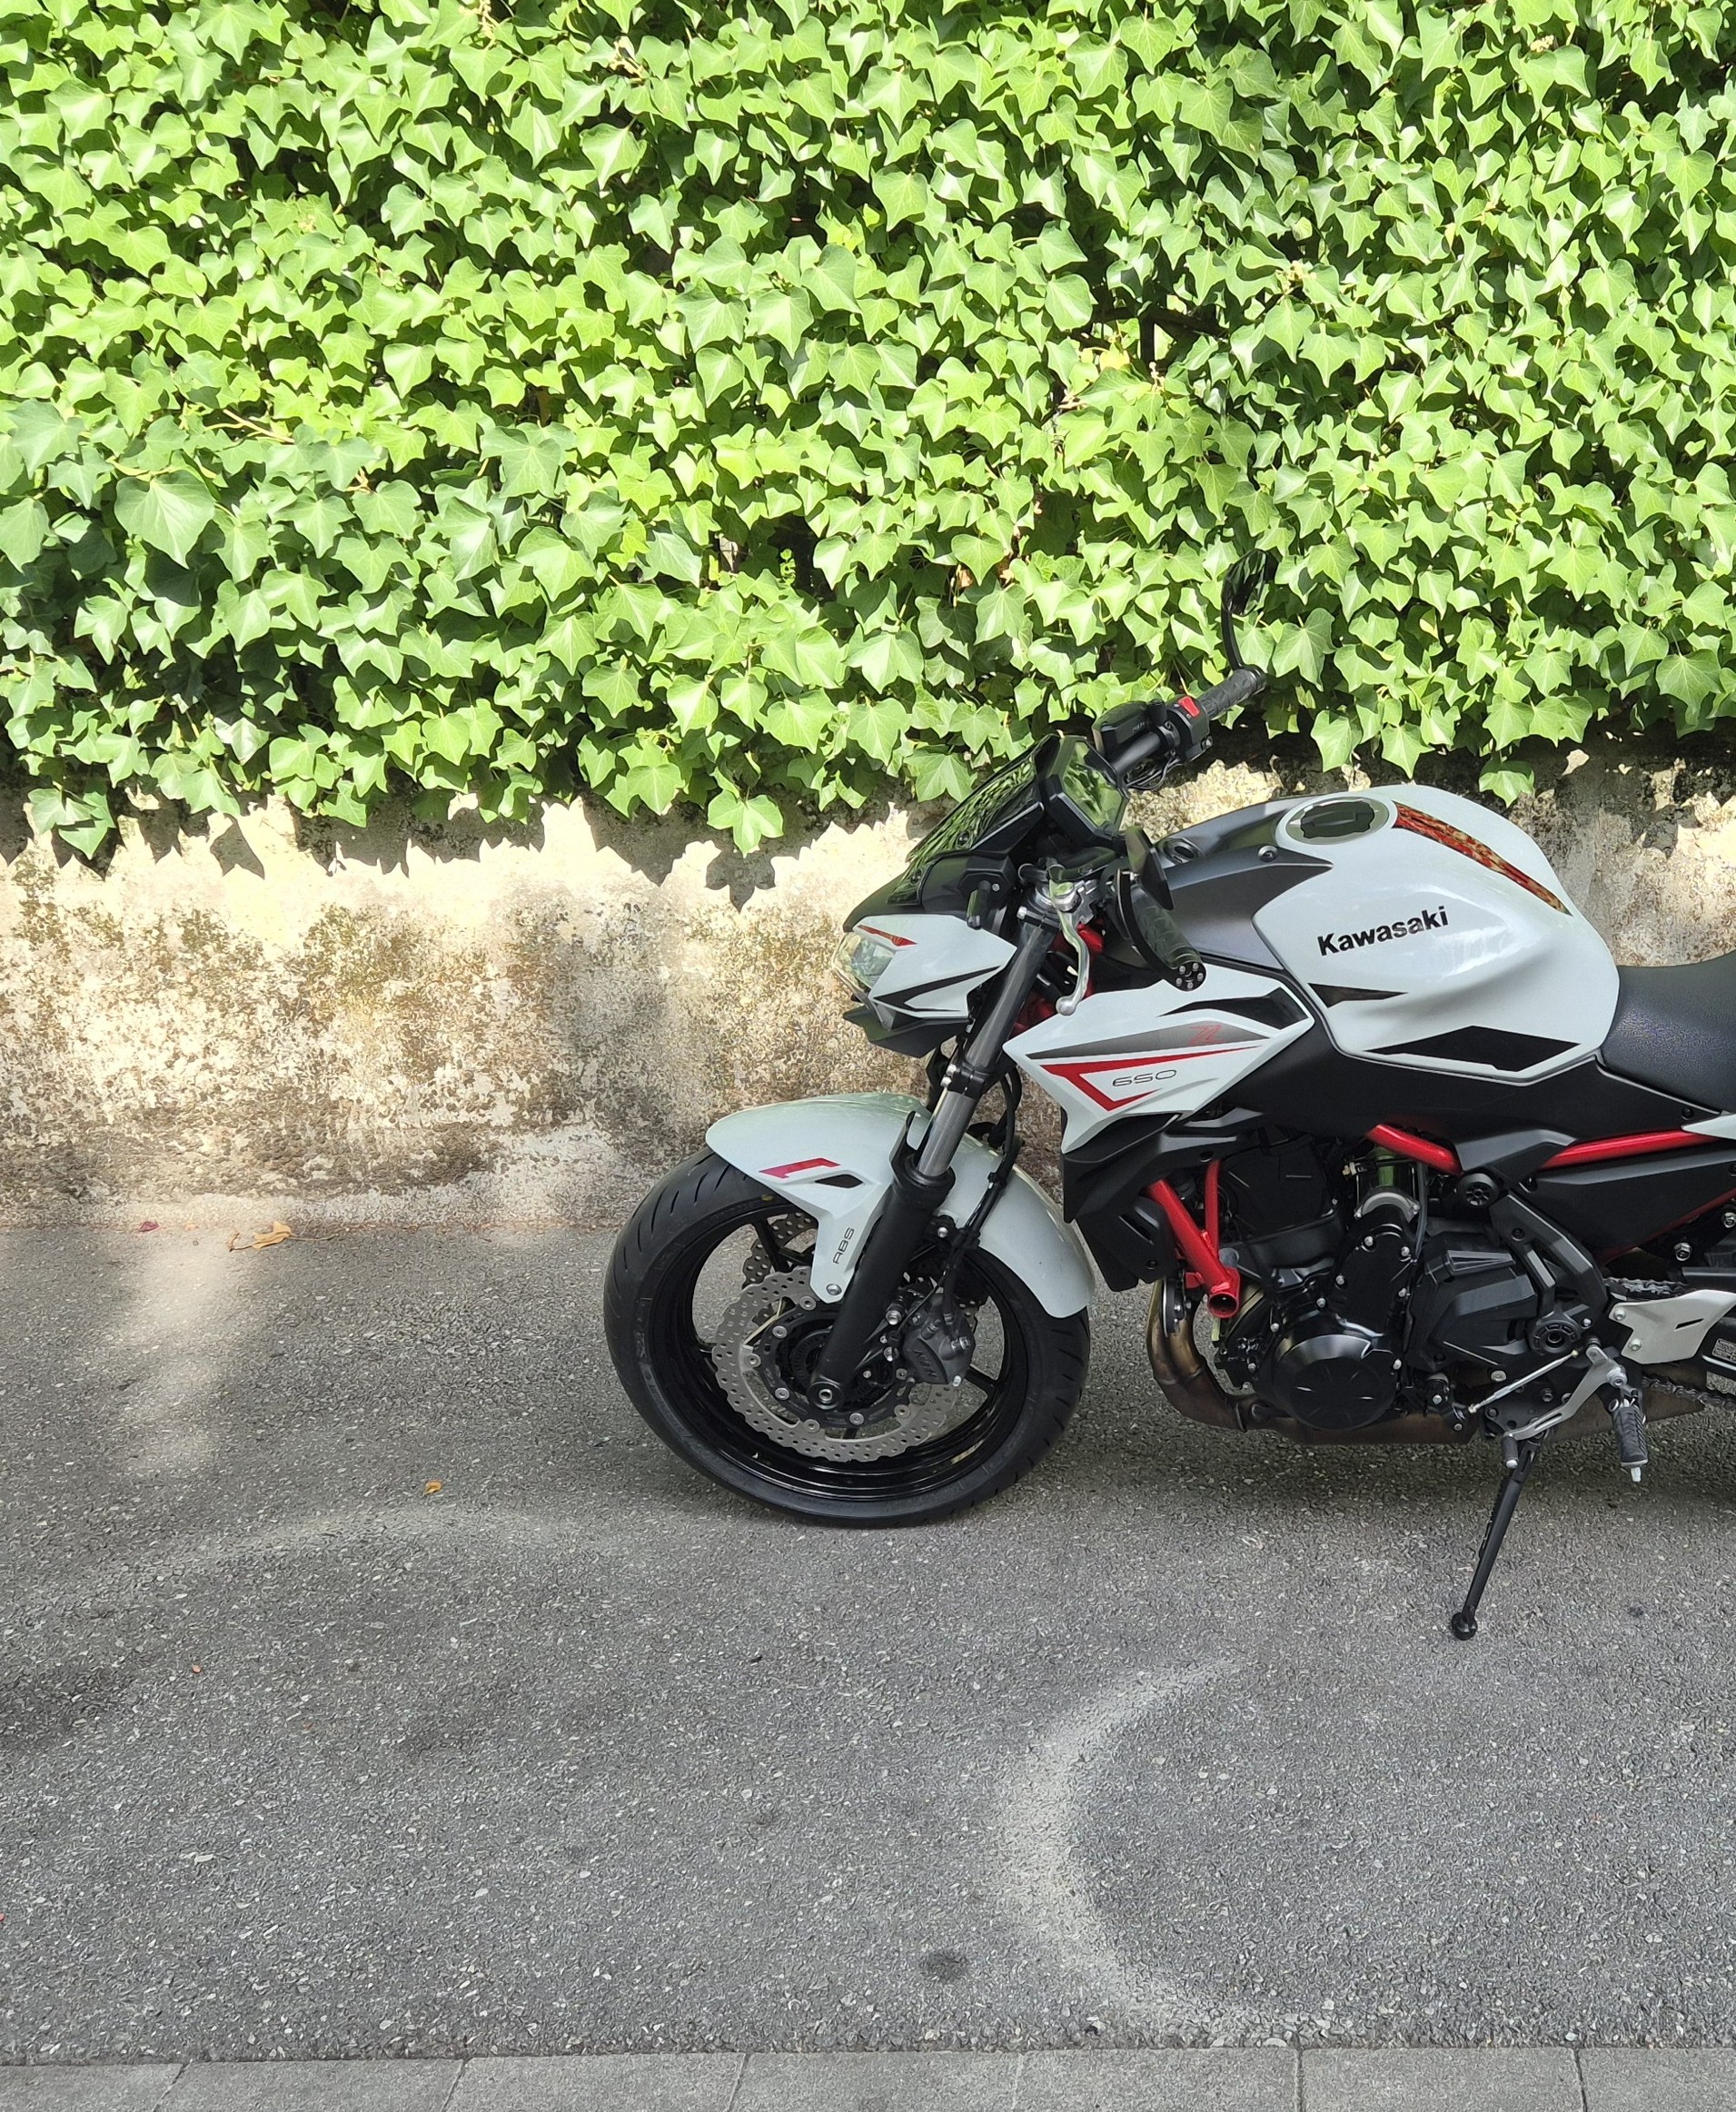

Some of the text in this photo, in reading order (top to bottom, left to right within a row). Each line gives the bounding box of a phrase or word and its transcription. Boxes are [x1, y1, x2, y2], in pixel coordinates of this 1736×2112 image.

[1317, 906, 1449, 957] Kawasaki
[1112, 1069, 1177, 1087] 650
[832, 1227, 855, 1264] ABS
